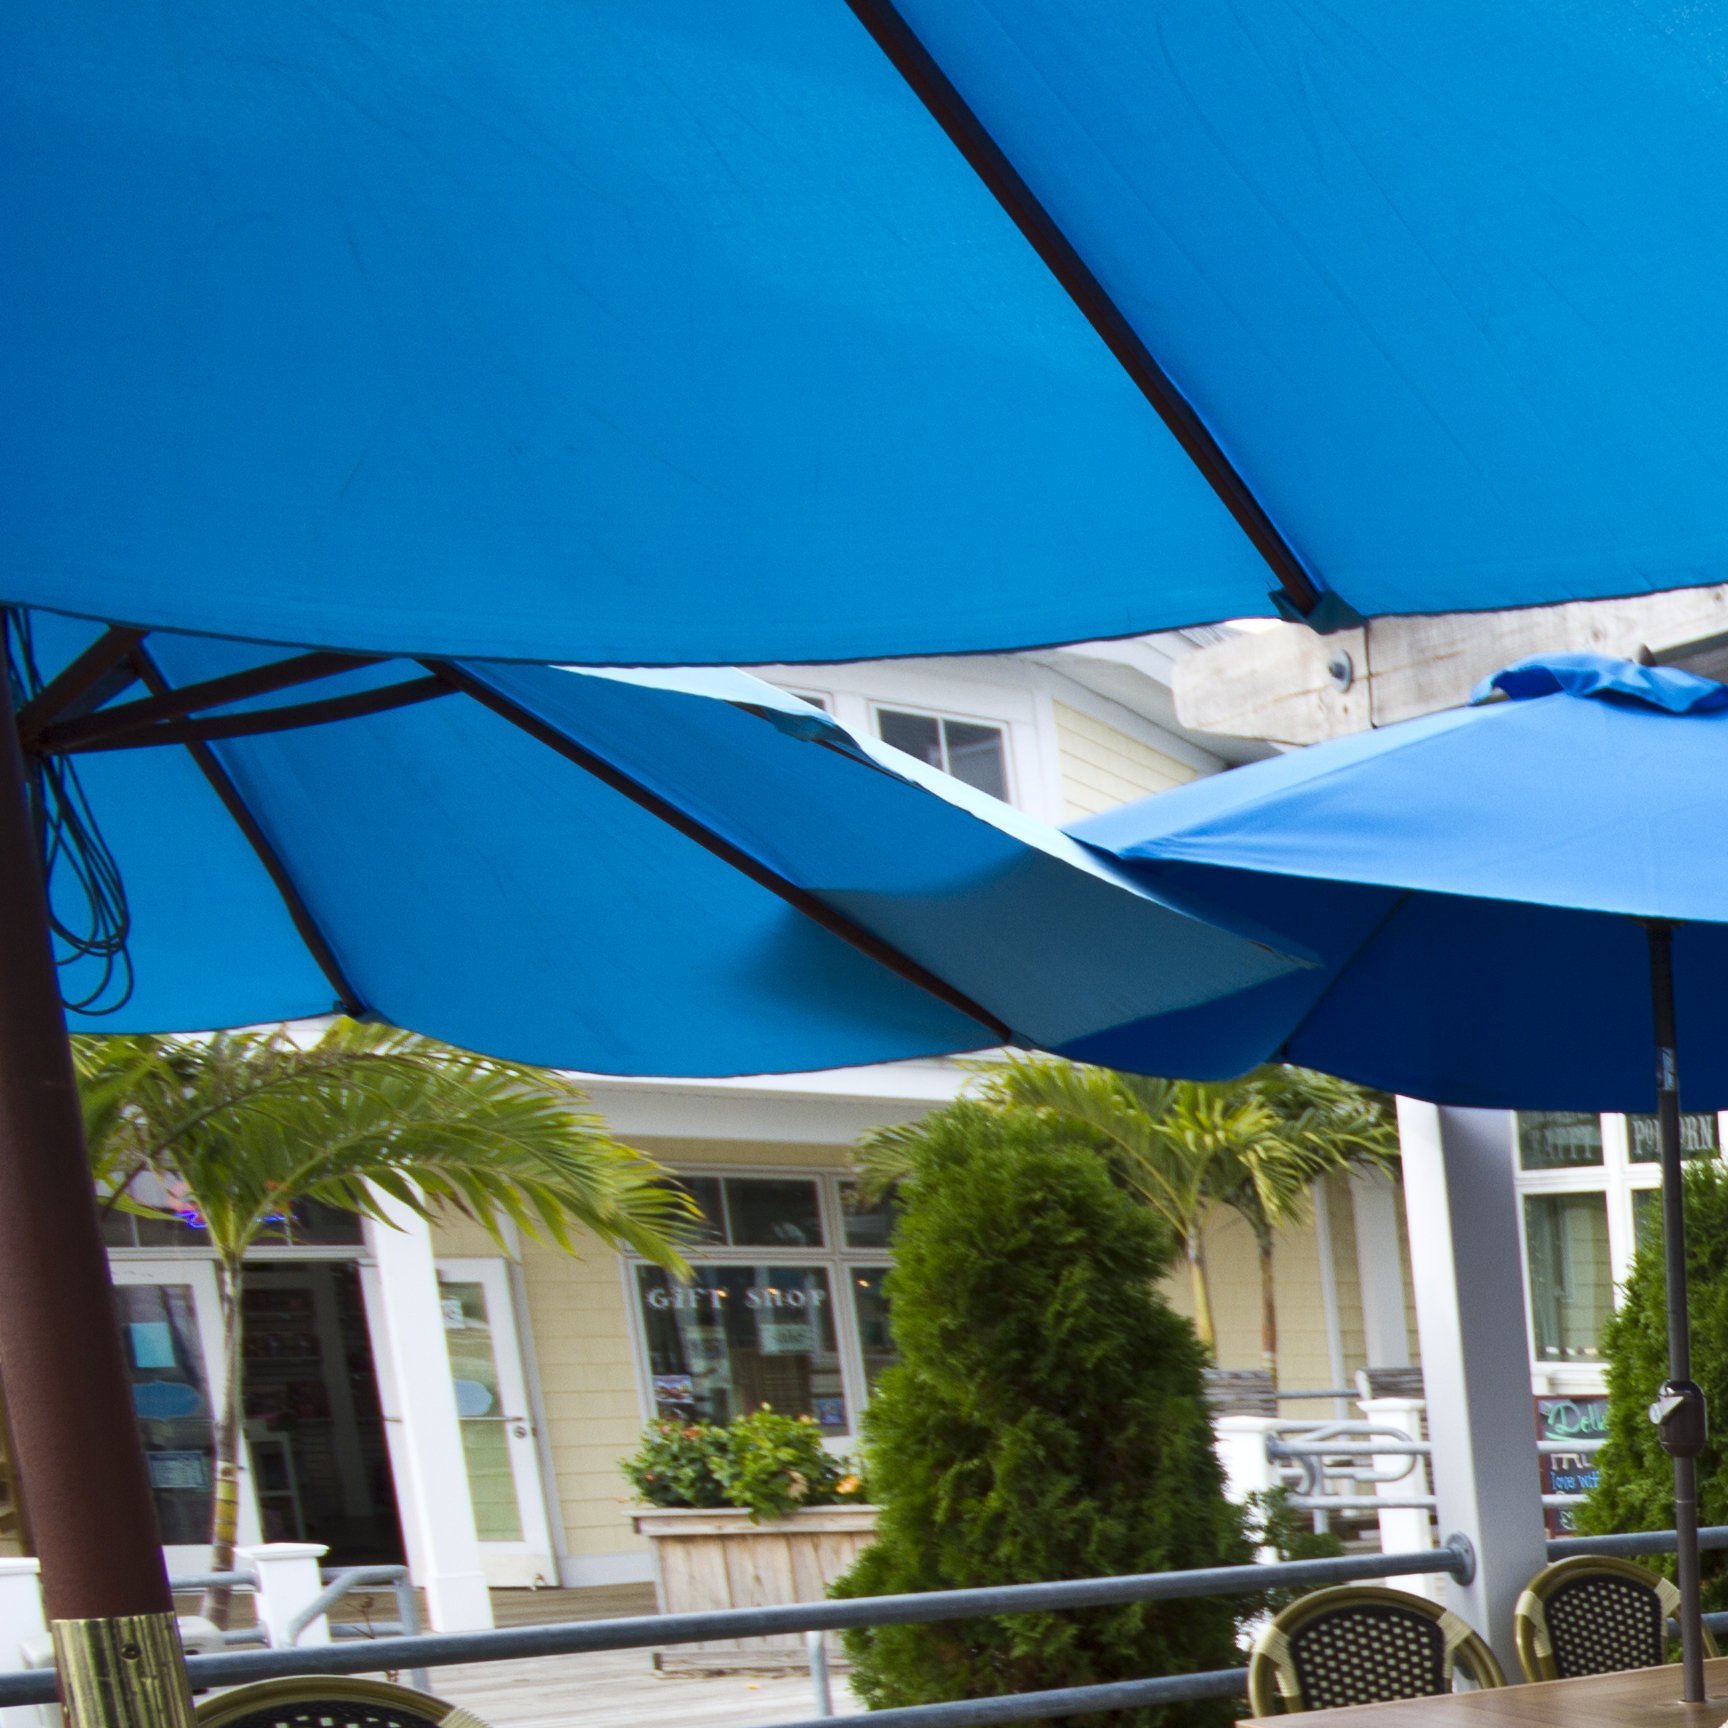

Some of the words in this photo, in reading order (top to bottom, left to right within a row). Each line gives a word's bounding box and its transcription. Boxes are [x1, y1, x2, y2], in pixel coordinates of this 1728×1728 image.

[645, 1286, 725, 1310] GIFT
[743, 1286, 827, 1310] SHOP
[1577, 1470, 1600, 1489] wit
